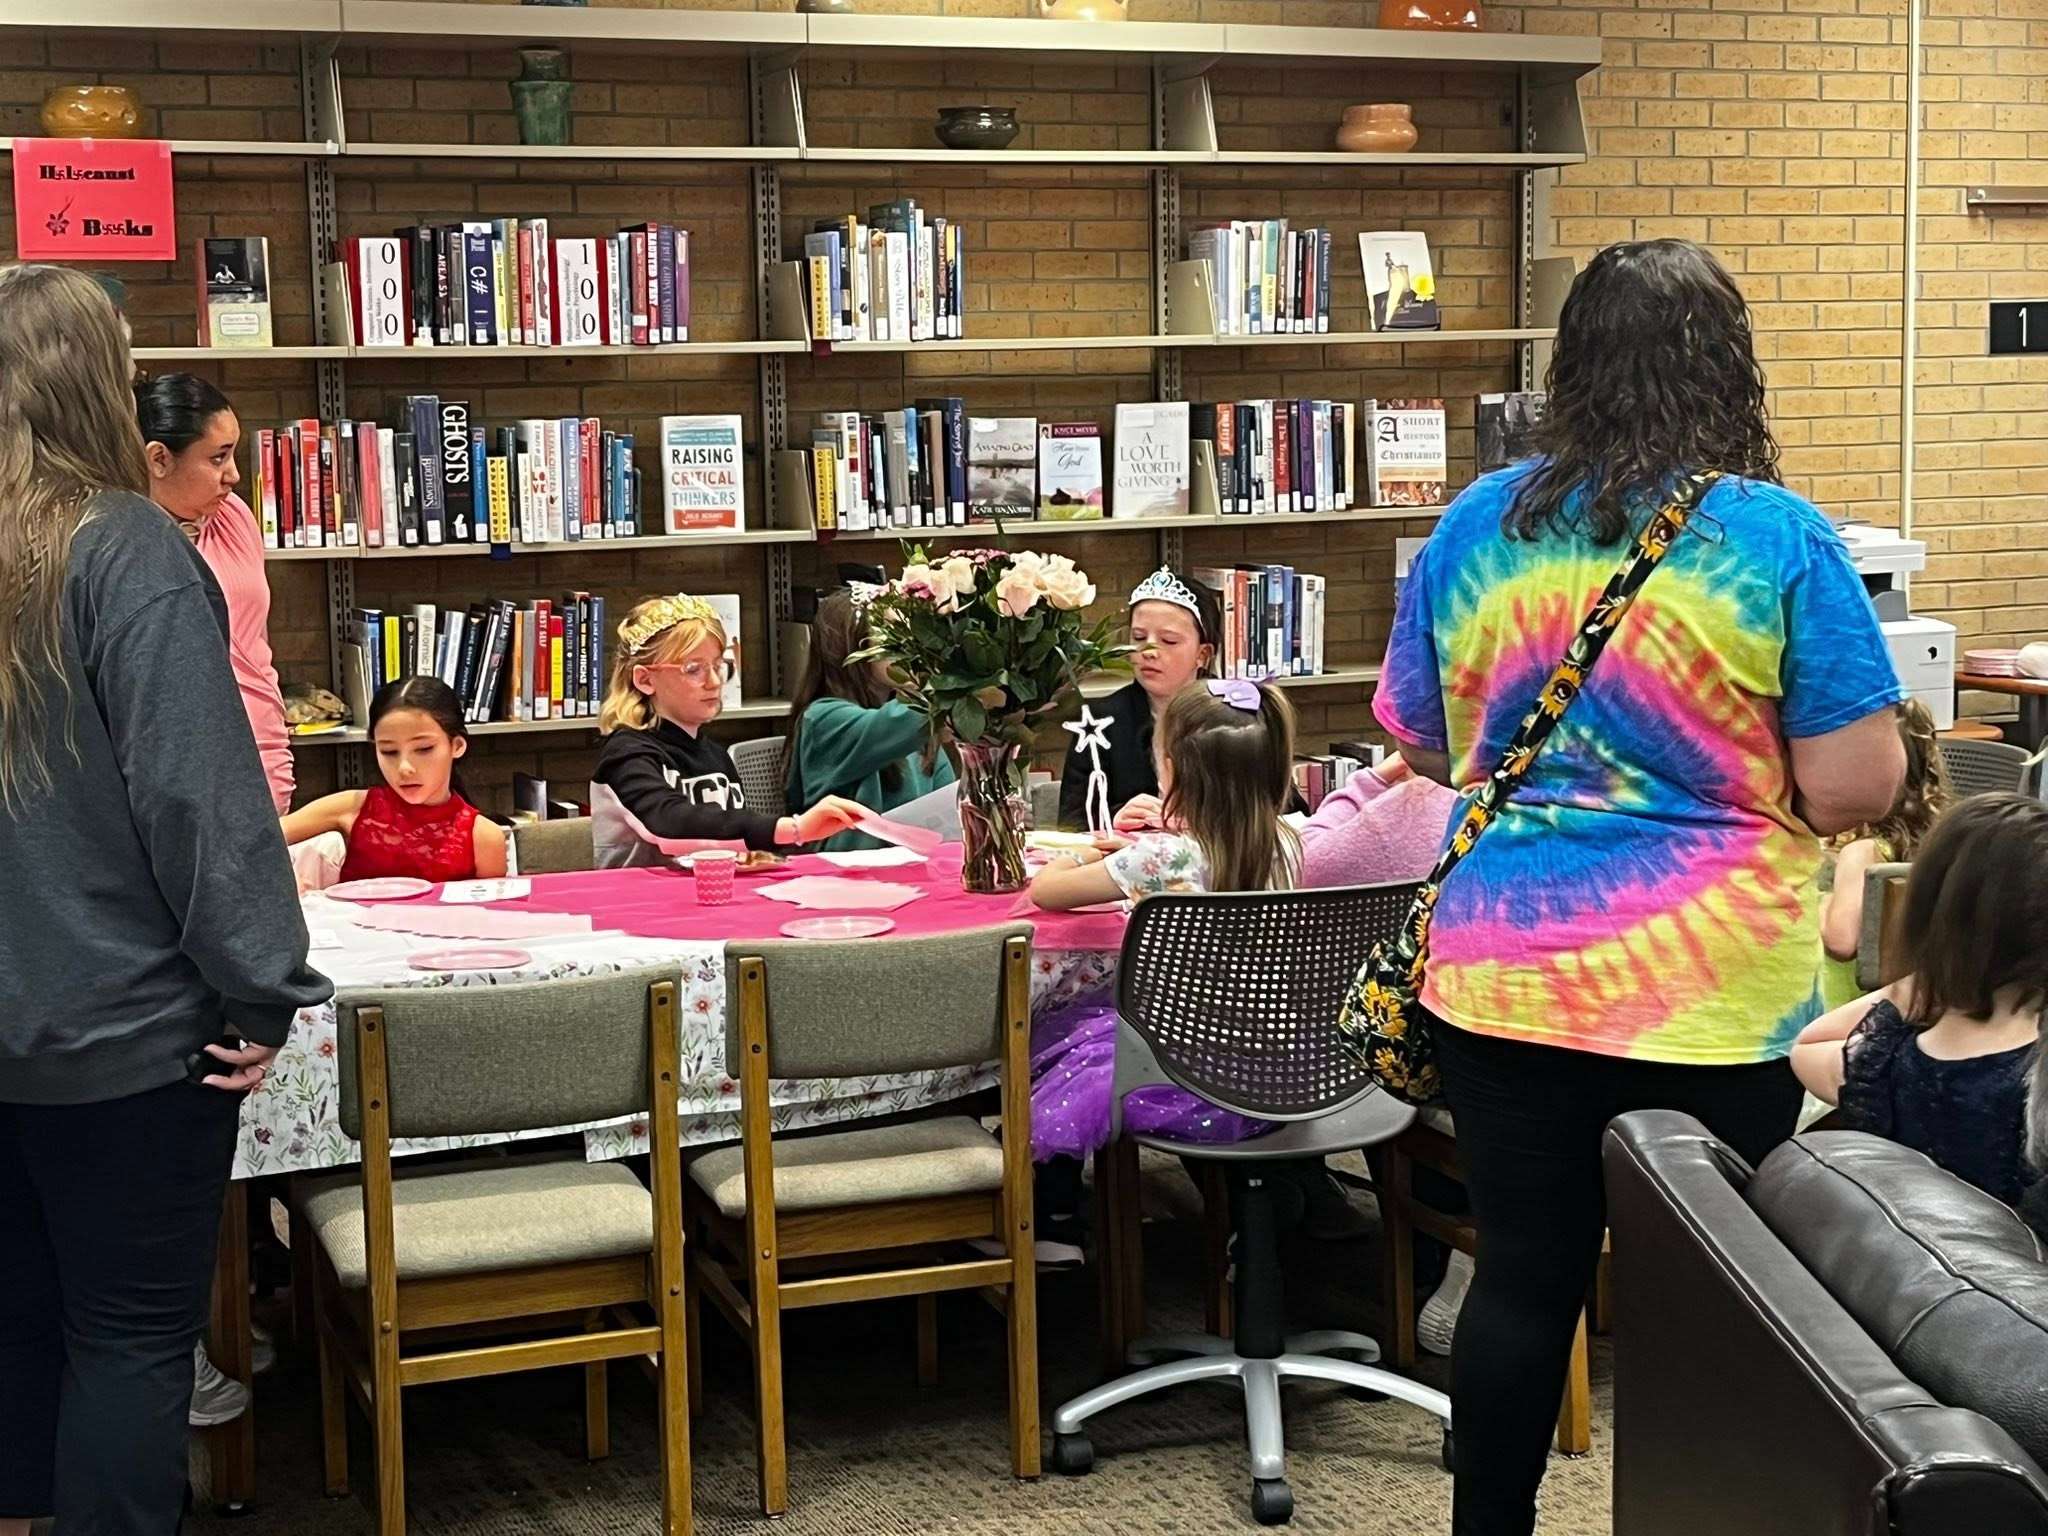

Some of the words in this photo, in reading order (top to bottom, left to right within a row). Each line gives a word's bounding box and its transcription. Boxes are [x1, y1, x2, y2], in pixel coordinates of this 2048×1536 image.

[470, 266, 489, 295] C#
[2018, 307, 2027, 347] 1
[1142, 432, 1153, 444] A
[1377, 416, 1400, 443] A
[1402, 417, 1441, 427] SHORT
[442, 405, 470, 484] GHOSTS
[672, 448, 733, 464] RAISING
[1119, 445, 1171, 462] LOVE
[1380, 450, 1442, 461] Christianity
[1130, 461, 1181, 474] WORTH
[671, 471, 735, 486] CRITICAL
[1118, 475, 1170, 488] GIVING
[672, 492, 736, 506] THINKERS
[502, 605, 514, 623] Real
[539, 609, 547, 628] BEST
[421, 624, 432, 666] Atomic
[539, 630, 548, 648] SELF
